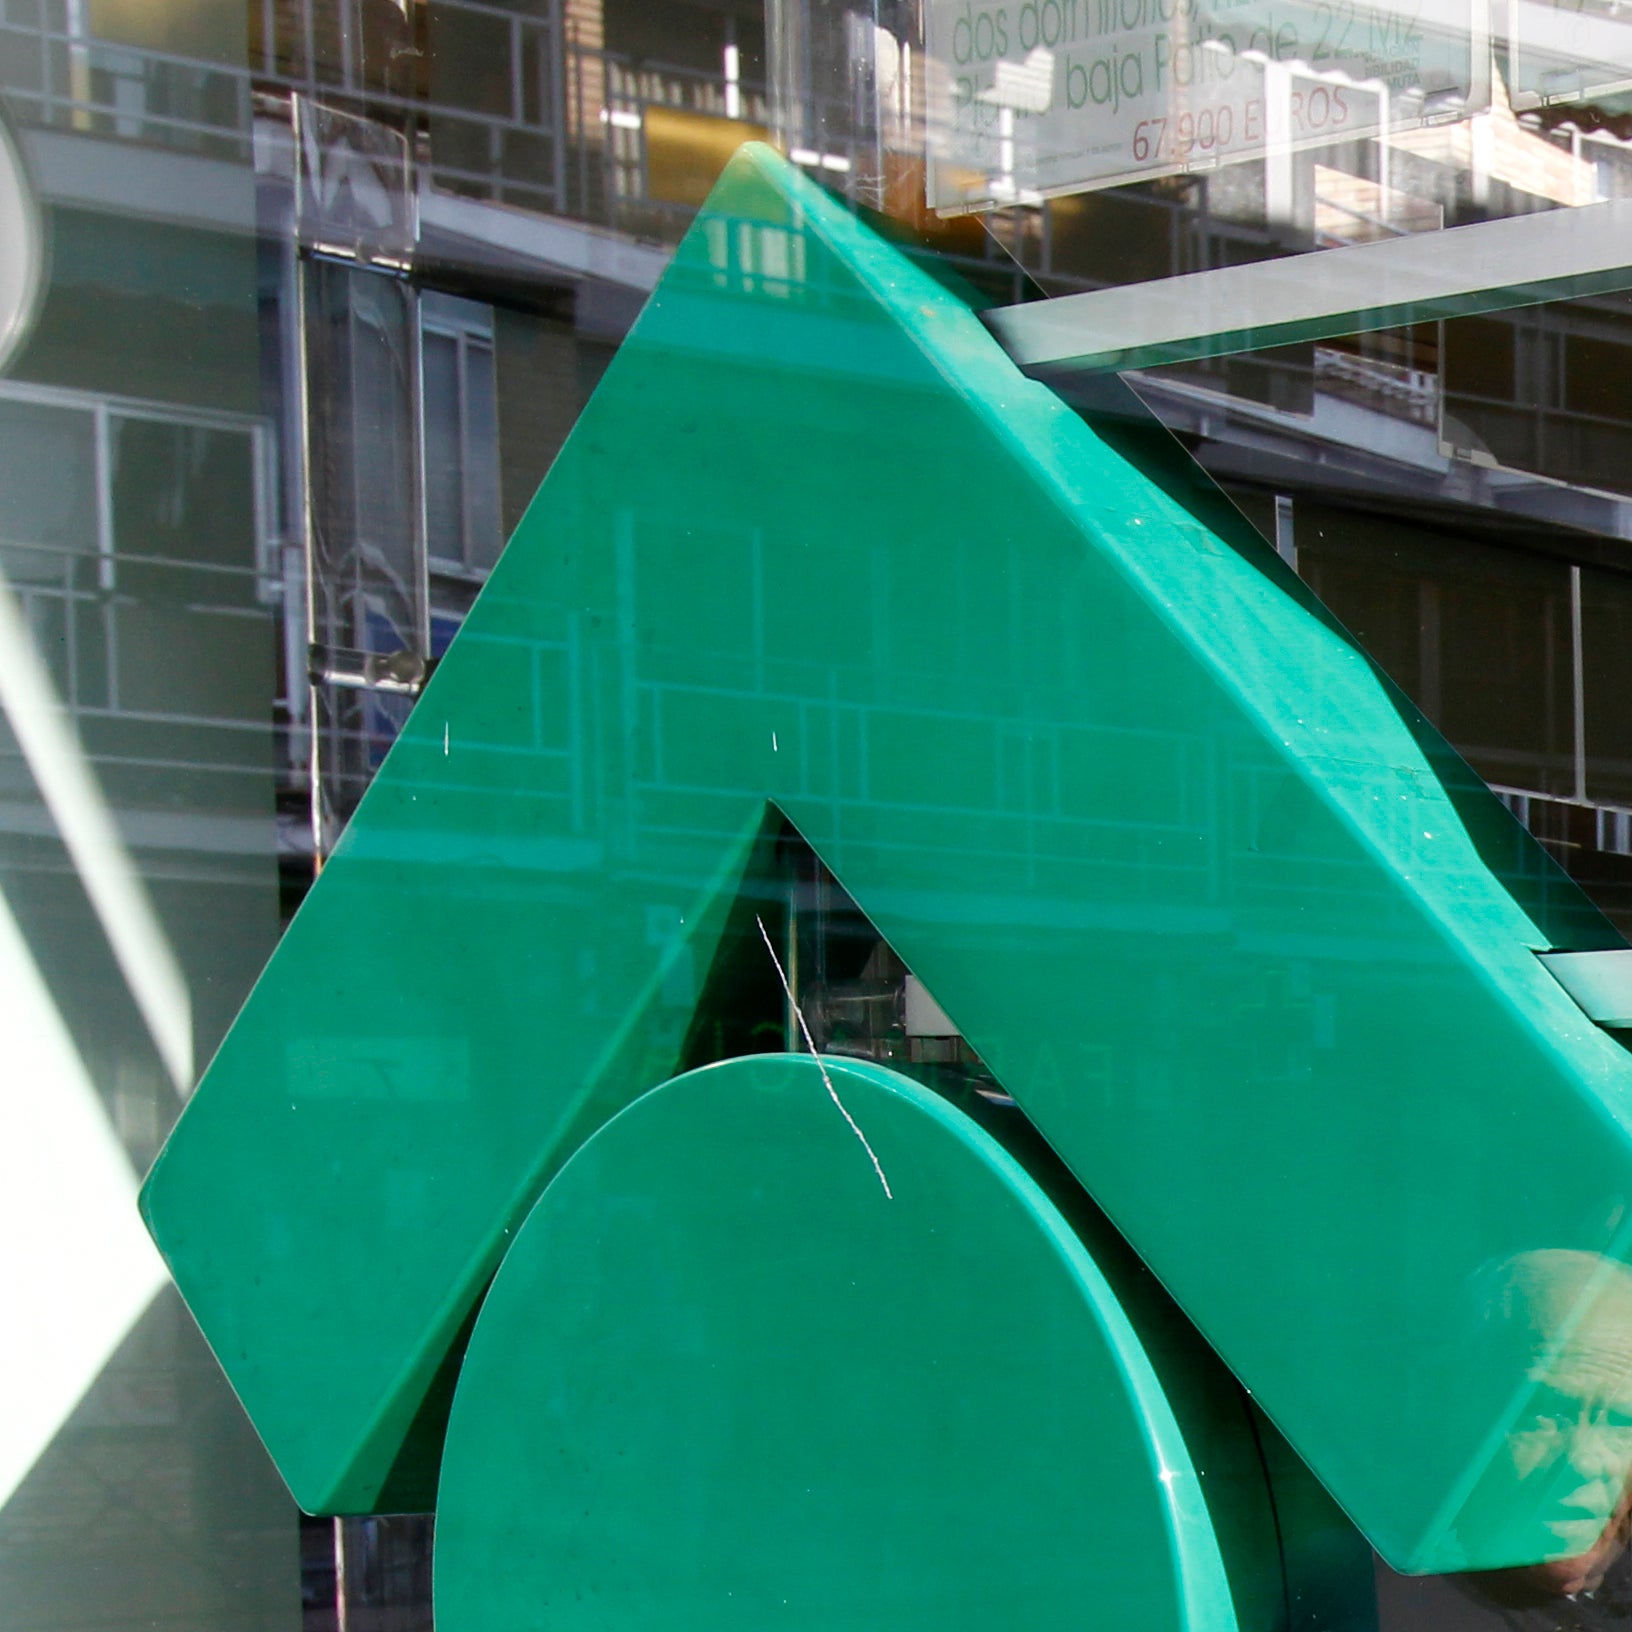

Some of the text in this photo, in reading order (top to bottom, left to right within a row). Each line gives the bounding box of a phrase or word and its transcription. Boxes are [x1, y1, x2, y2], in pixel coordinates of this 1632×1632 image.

[953, 4, 1009, 65] dos
[1066, 53, 1145, 114] baja
[1133, 105, 1232, 161] 67.900
[1245, 87, 1349, 141] EUROS
